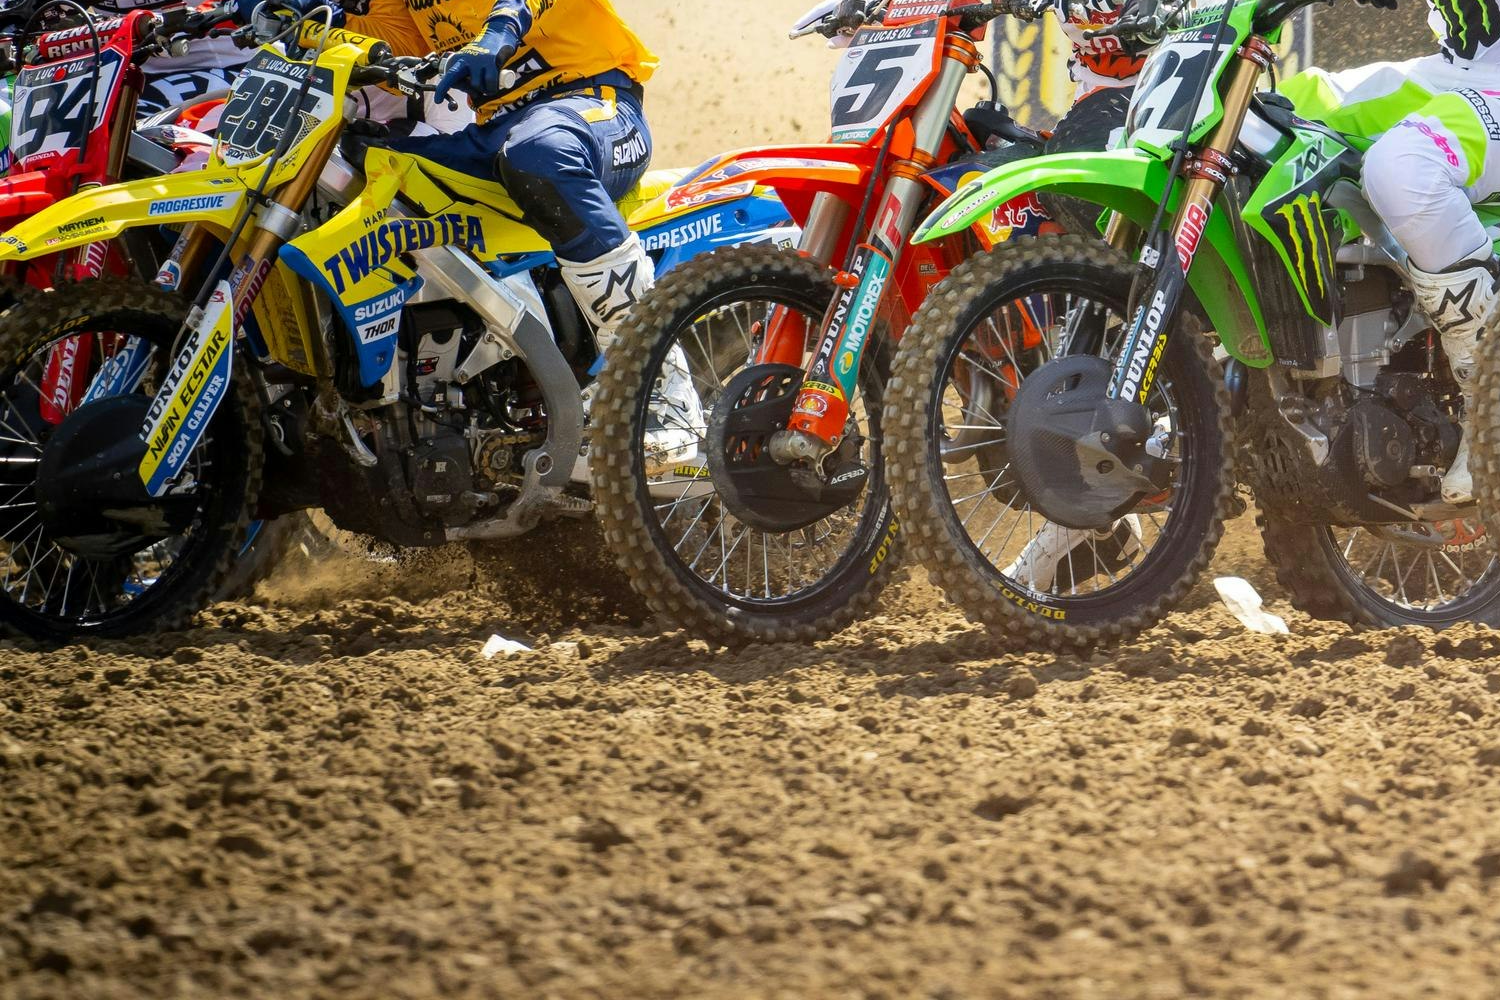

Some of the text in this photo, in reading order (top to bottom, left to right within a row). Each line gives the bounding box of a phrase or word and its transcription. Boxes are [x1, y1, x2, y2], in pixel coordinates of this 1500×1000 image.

[868, 27, 914, 43] LUCAS OIL
[1183, 31, 1201, 43] OIL
[67, 61, 84, 74] OIL
[266, 58, 308, 80] LUCAS OIL
[831, 44, 921, 127] 5
[841, 129, 871, 141] MOTOREX
[26, 151, 56, 163] HONDA
[150, 195, 225, 215] PROGRESSIVE
[57, 216, 106, 235] MAYHEM
[323, 213, 488, 296] TWISTED TEA
[354, 290, 405, 321] SUZUKI
[822, 255, 866, 358] DUNLOP
[844, 271, 888, 353] MOTOREX
[364, 317, 396, 340] THOR
[1120, 290, 1165, 403] DUNLOP
[182, 330, 229, 408] ECSTAR
[1139, 333, 1169, 405] ACERBIS
[139, 330, 201, 441] DUNLOP
[187, 374, 226, 430] GALFER
